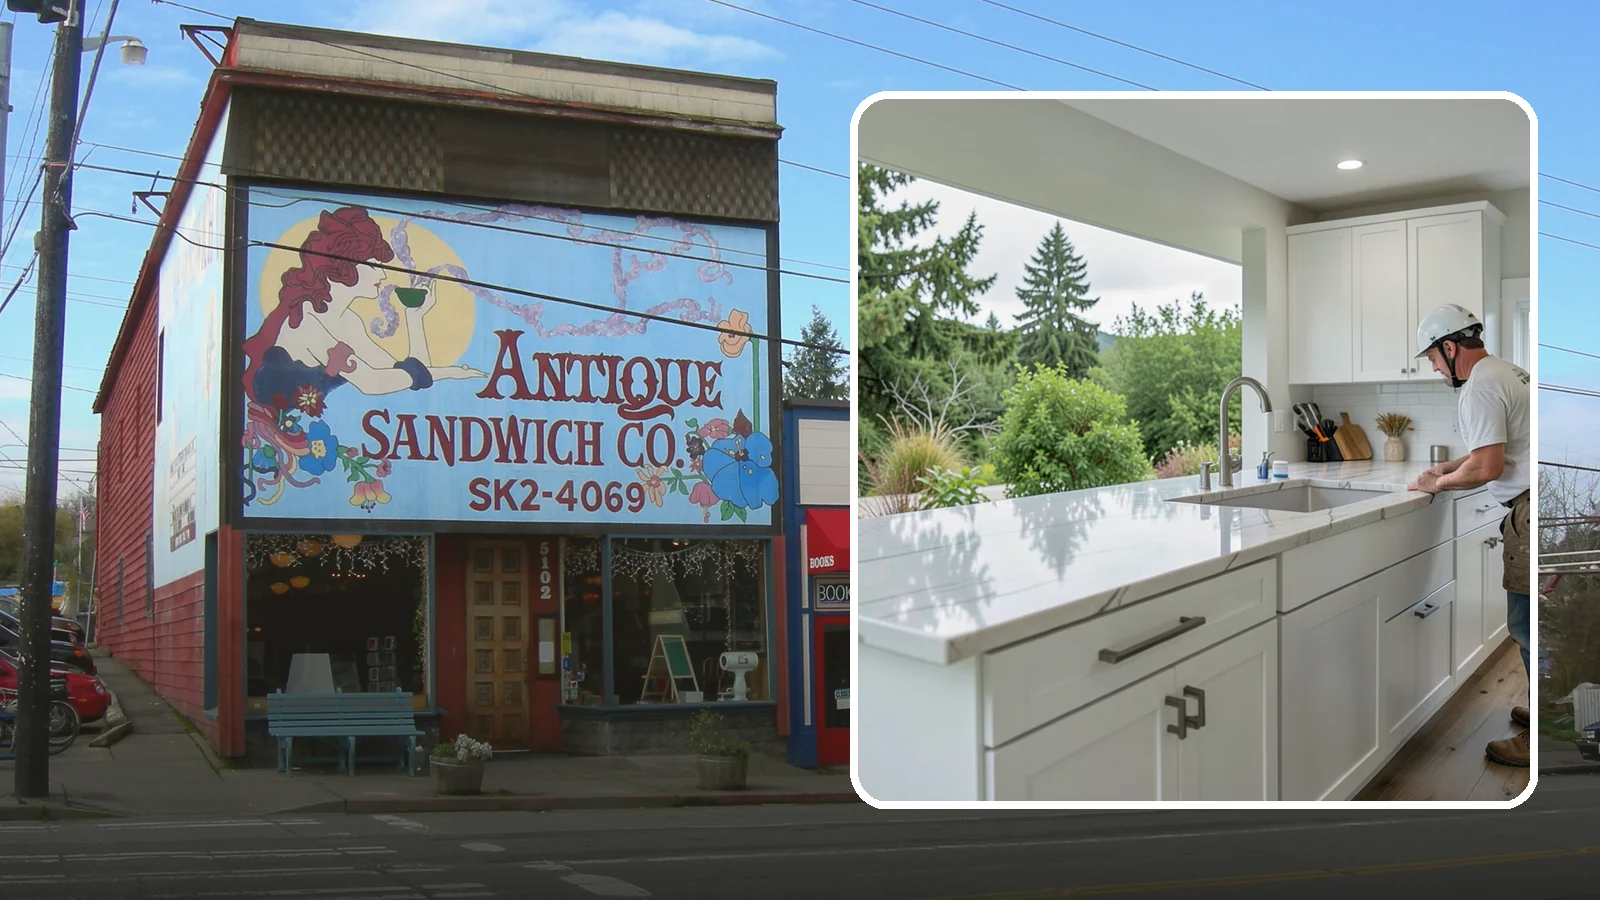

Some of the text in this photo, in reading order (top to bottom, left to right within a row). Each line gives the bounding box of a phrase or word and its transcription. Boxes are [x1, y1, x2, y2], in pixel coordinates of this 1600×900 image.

[475, 329, 723, 421] ANTIQUE
[361, 408, 685, 470] SANDWICH CO.
[468, 477, 646, 513] SK2-4069
[539, 541, 552, 600] 5102
[809, 555, 835, 569] BOOKS
